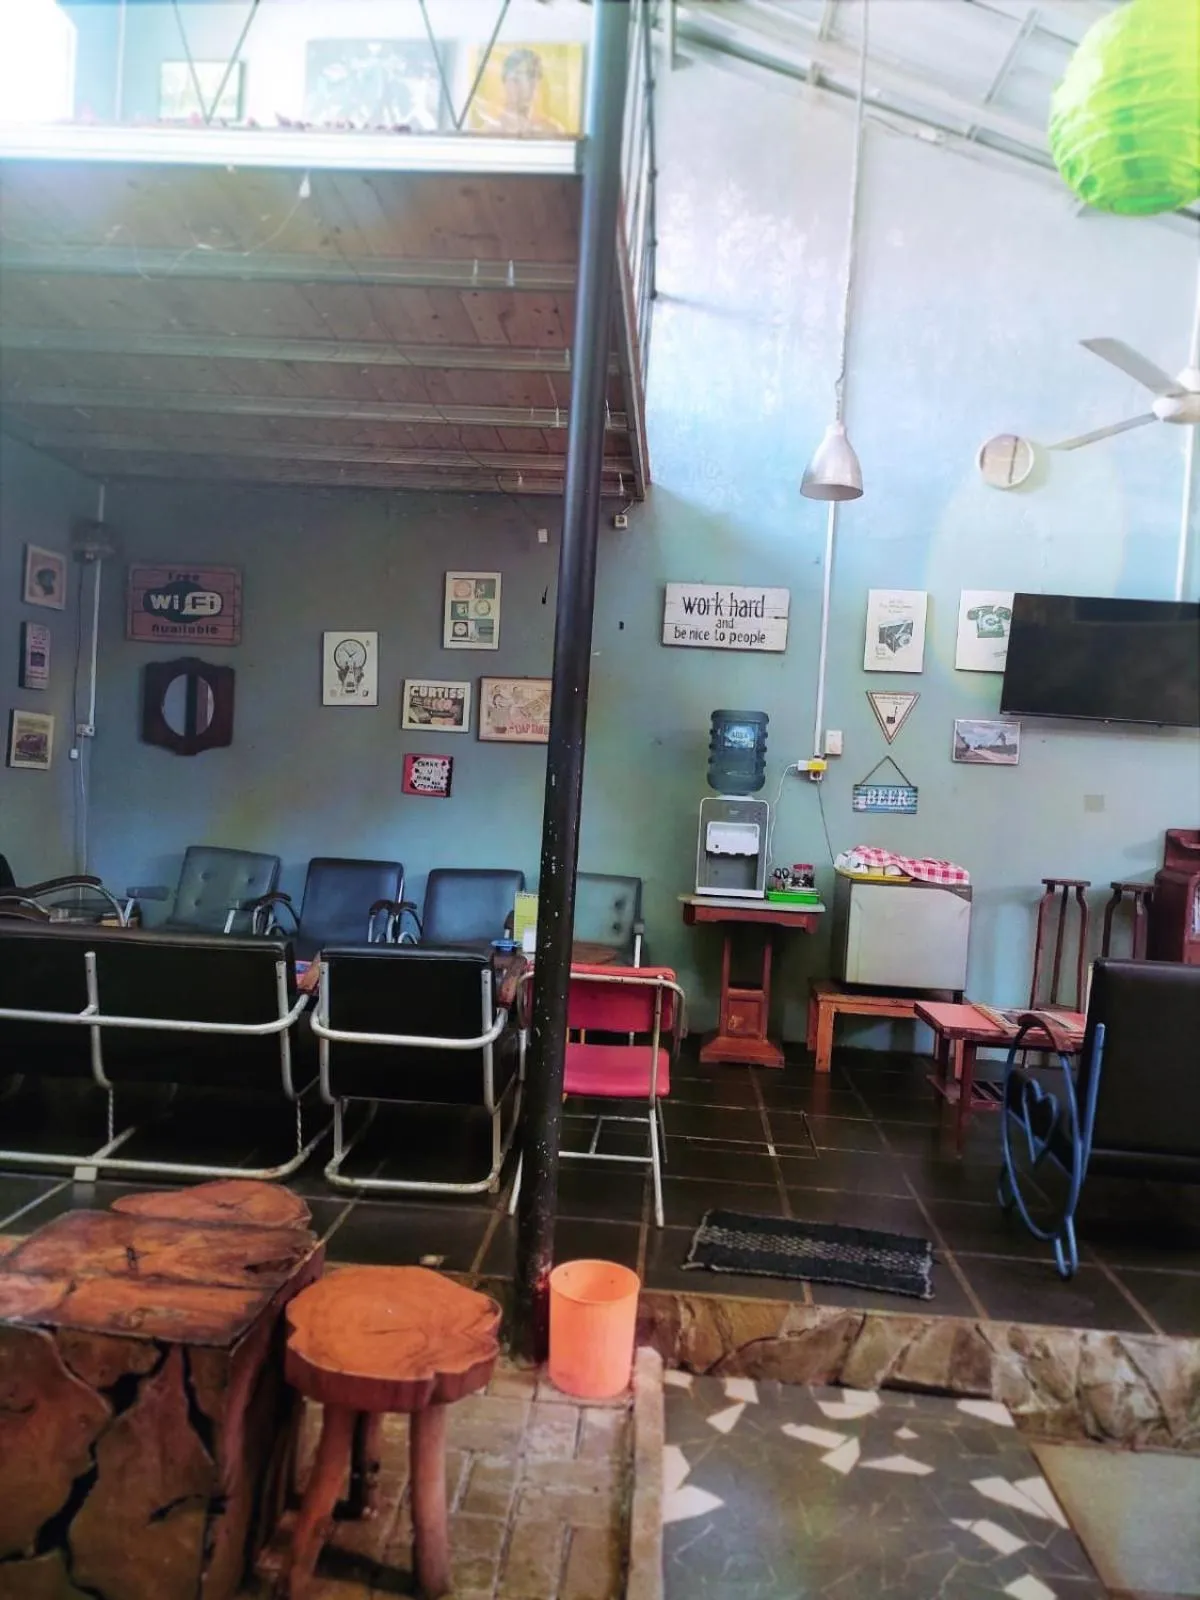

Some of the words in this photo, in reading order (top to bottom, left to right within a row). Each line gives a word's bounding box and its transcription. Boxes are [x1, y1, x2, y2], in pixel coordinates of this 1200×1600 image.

[683, 592, 724, 616] work
[730, 592, 765, 618] hard
[716, 618, 734, 629] and
[674, 626, 687, 639] be
[689, 628, 710, 641] nice
[715, 630, 726, 642] to
[729, 631, 766, 646] people
[410, 686, 465, 699] CURTISS
[867, 789, 909, 806] BEER
